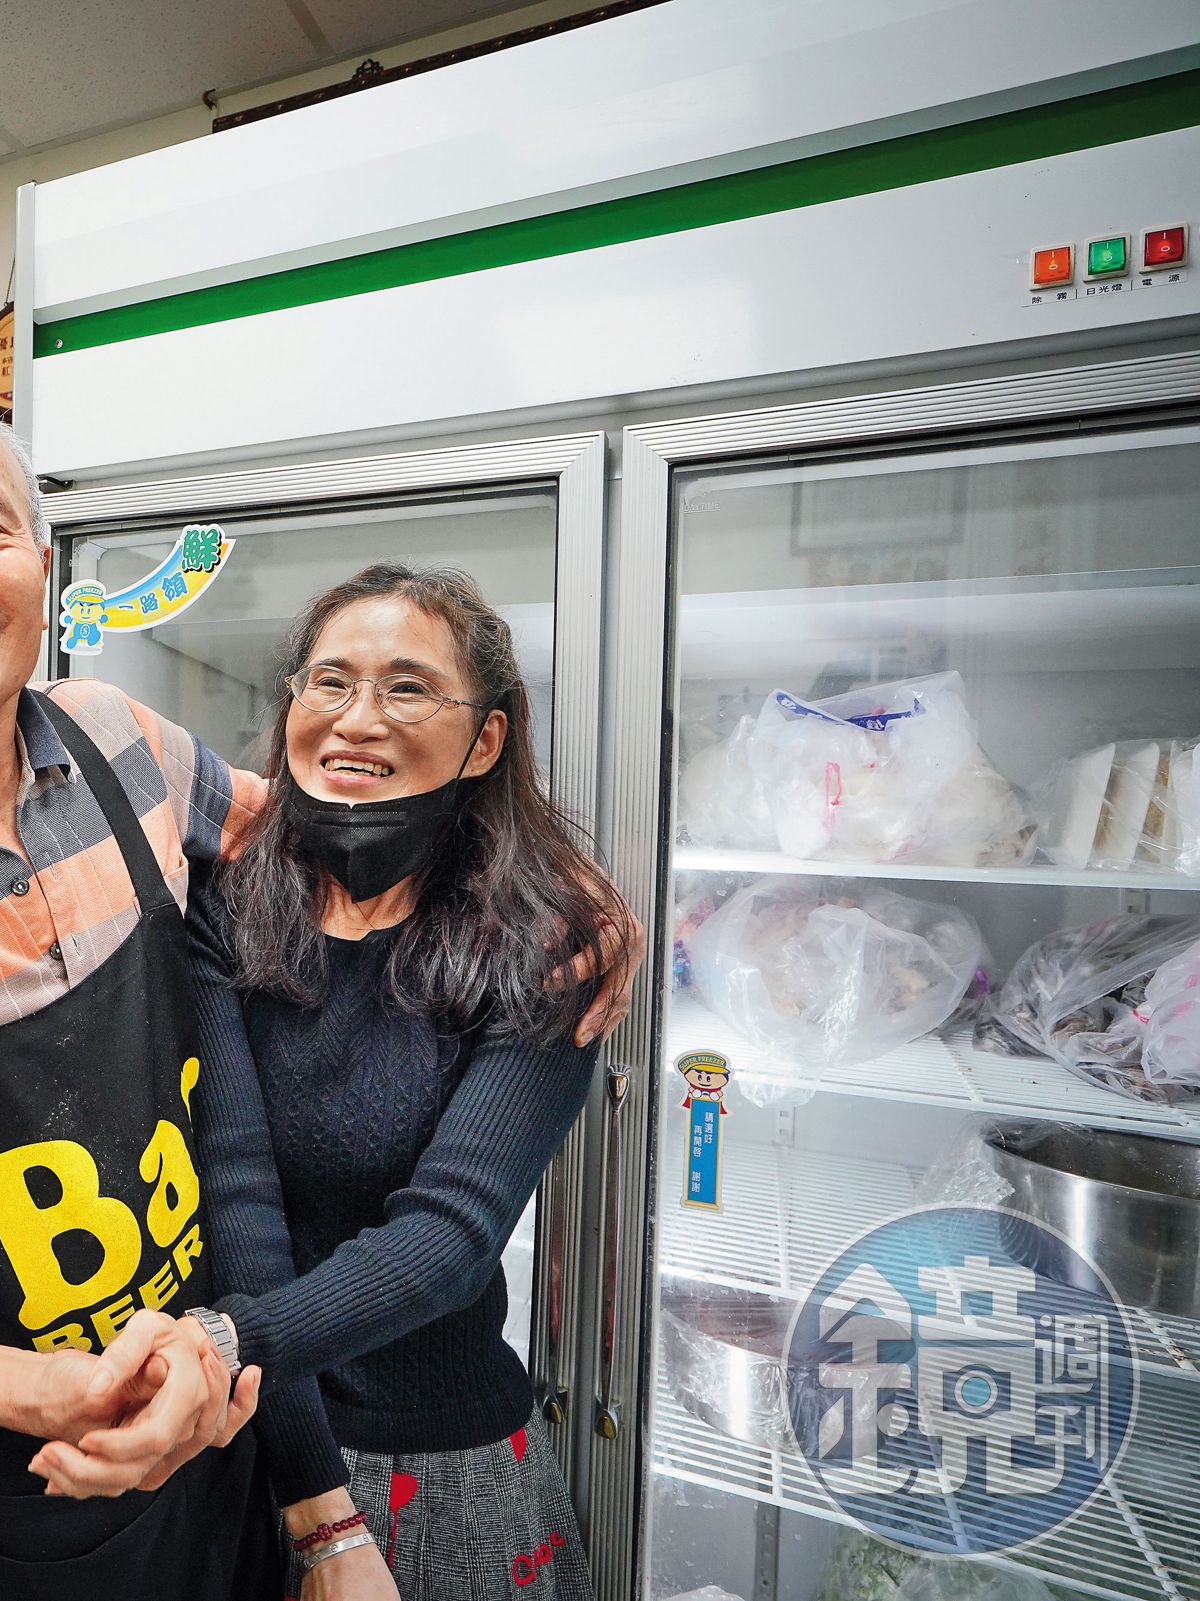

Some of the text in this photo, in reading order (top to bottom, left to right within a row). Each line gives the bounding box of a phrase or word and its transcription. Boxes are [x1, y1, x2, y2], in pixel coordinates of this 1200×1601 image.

[679, 1056, 725, 1070] SUPER FREEZER
[32, 1223, 203, 1353] BEER
